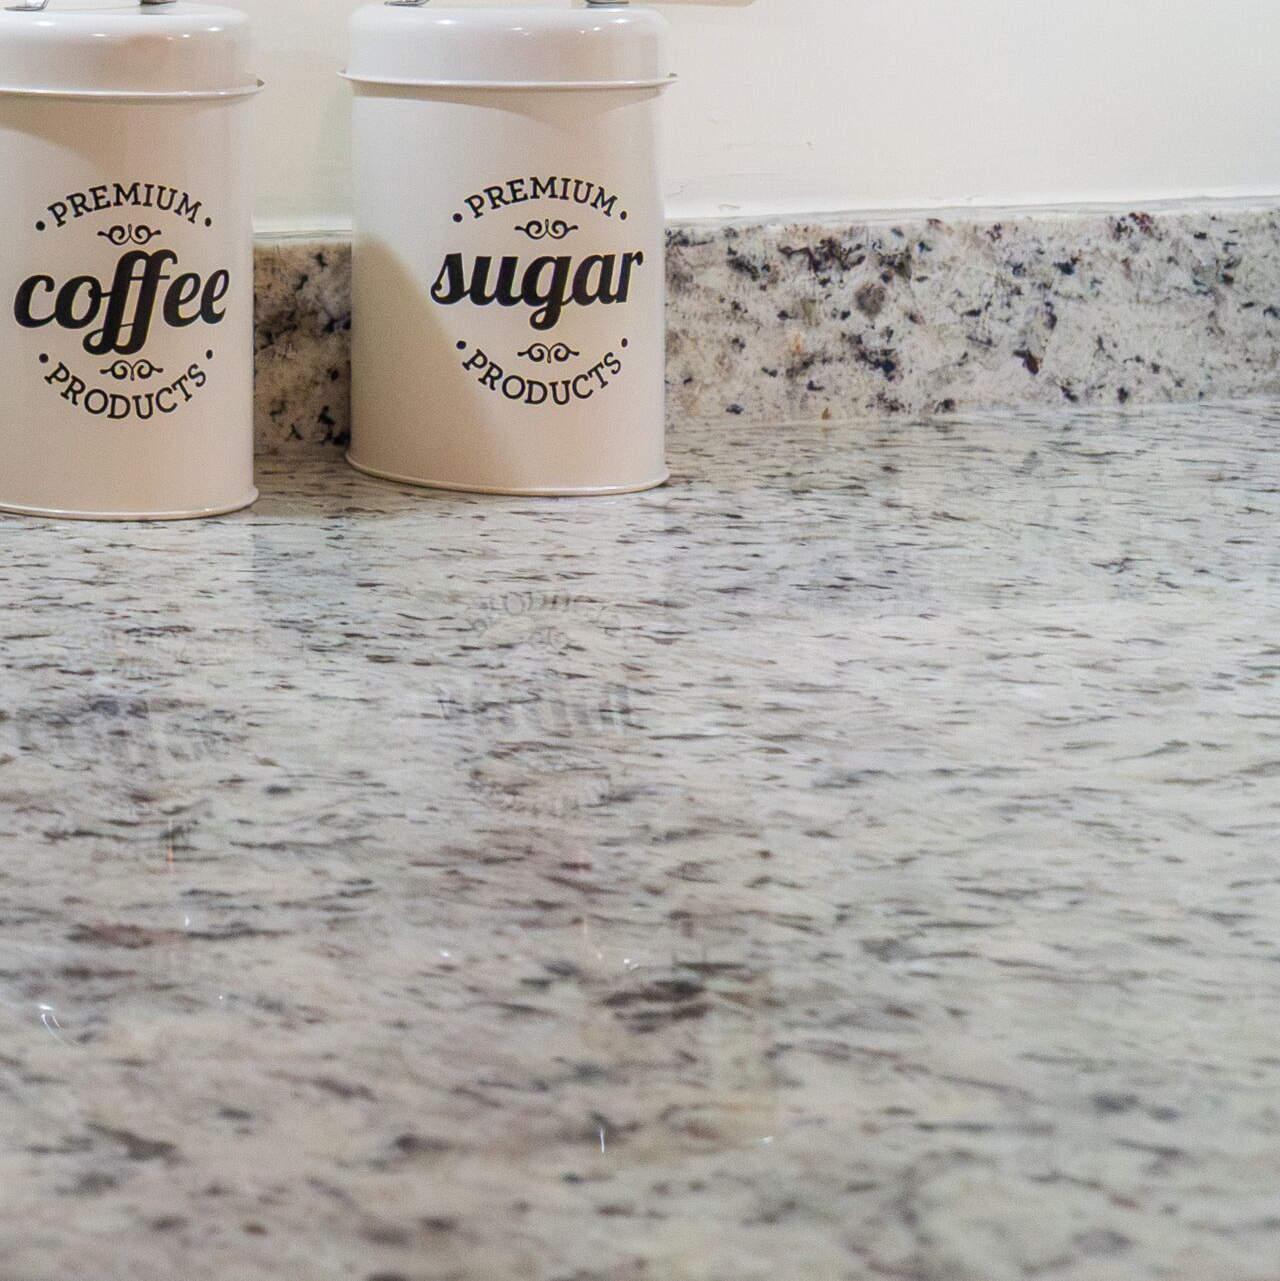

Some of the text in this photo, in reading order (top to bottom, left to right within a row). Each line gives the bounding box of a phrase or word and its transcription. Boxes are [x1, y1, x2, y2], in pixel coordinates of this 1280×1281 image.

[47, 182, 203, 228] PREMIUM
[464, 176, 618, 219] PREMIUM
[14, 249, 230, 355] coffee
[430, 251, 644, 331] sugar
[44, 362, 206, 419] PRODUCTS
[462, 349, 622, 405] PRODUCTS
